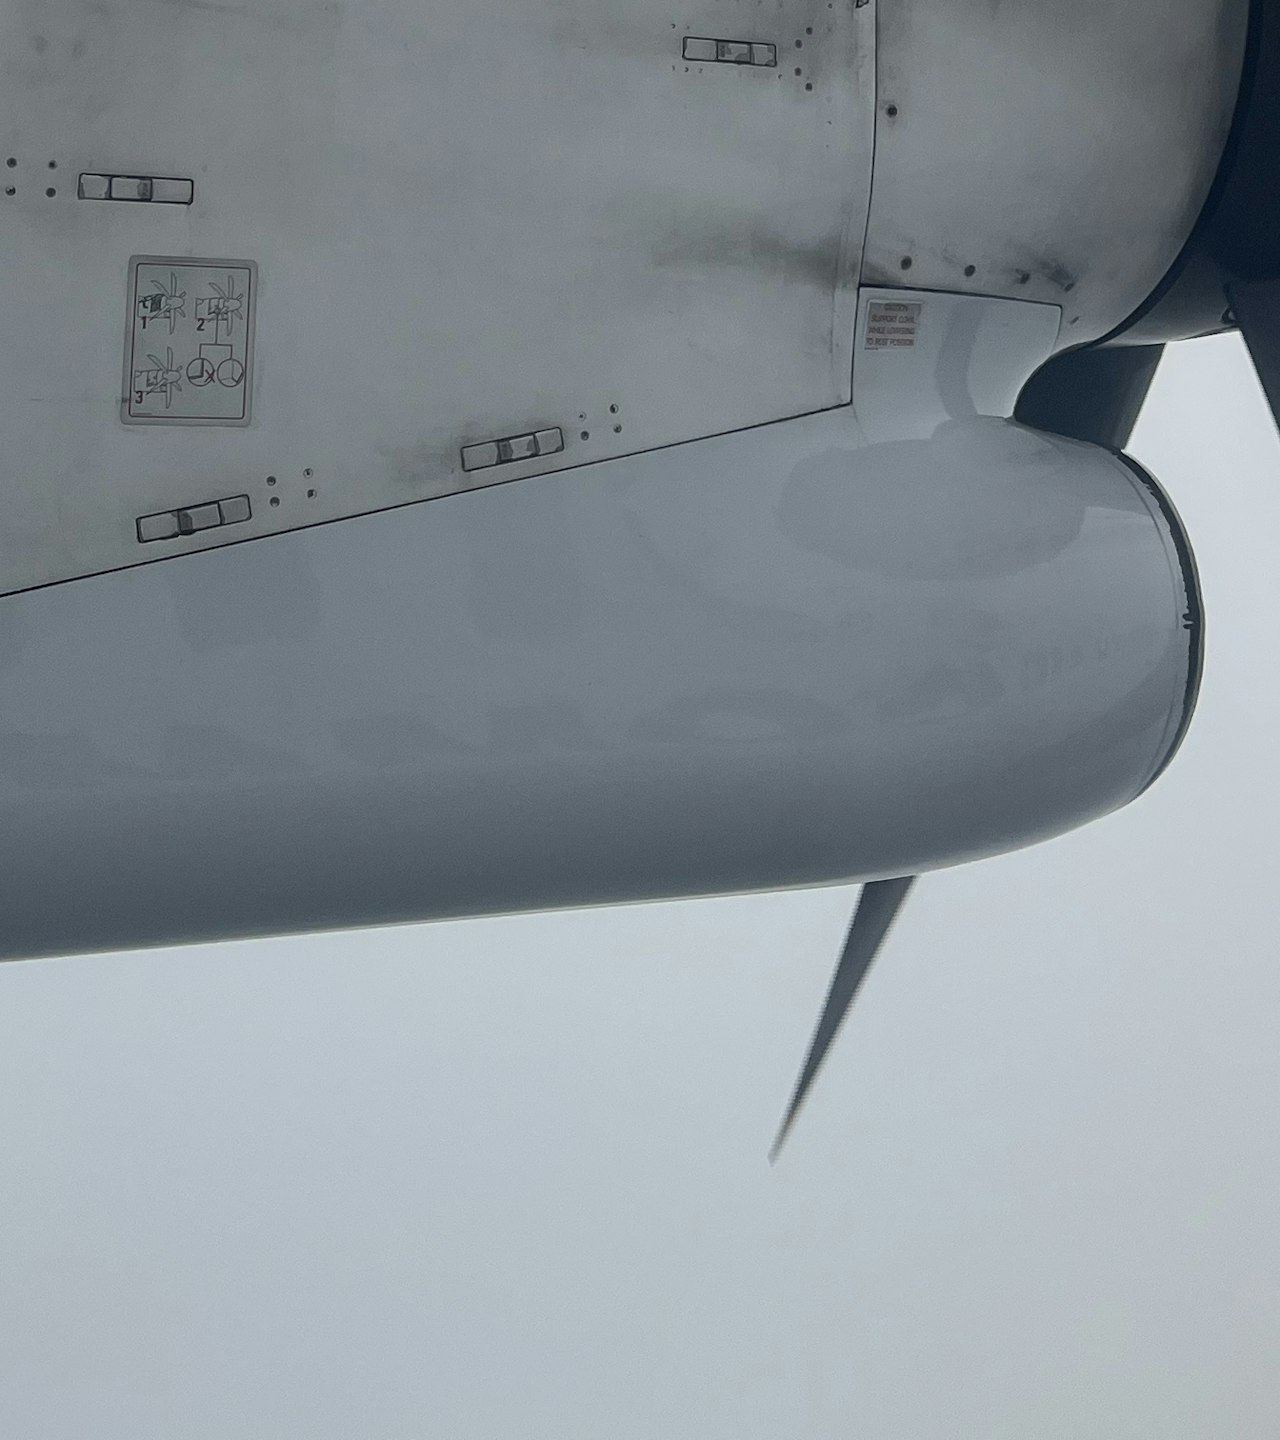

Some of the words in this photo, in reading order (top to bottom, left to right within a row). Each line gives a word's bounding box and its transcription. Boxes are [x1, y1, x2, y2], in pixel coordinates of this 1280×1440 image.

[141, 317, 147, 329] 1
[871, 314, 897, 322] SUPPORT
[196, 318, 205, 331] 2
[868, 326, 886, 334] WHILE
[886, 326, 915, 335] LOWERING
[866, 337, 874, 345] TO
[889, 338, 915, 347] POSITION
[135, 390, 143, 404] 3
